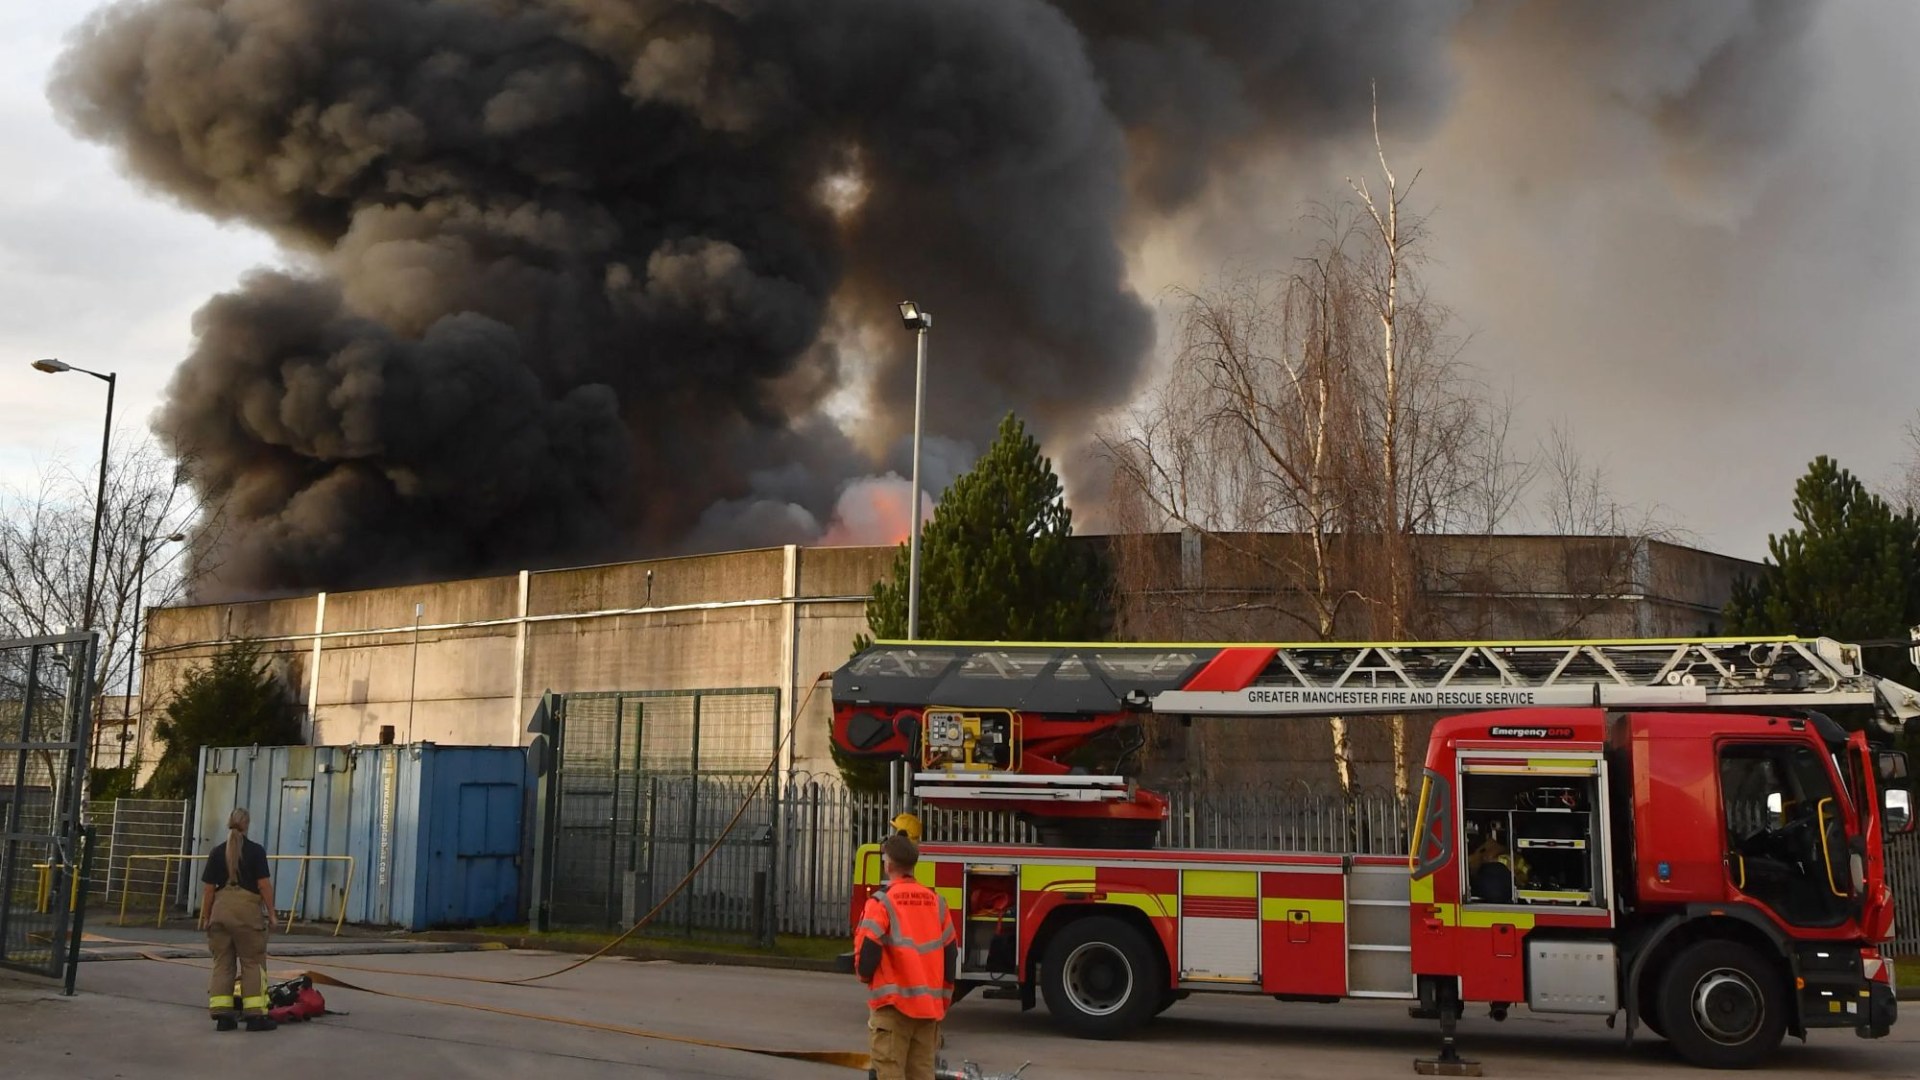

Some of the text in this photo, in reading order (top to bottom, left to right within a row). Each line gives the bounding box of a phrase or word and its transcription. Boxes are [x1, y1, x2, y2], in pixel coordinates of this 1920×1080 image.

[1248, 691, 1534, 704] GREATER MANCHESTER FIRE AND RESCUE SERVICE
[1492, 727, 1547, 737] Emergency
